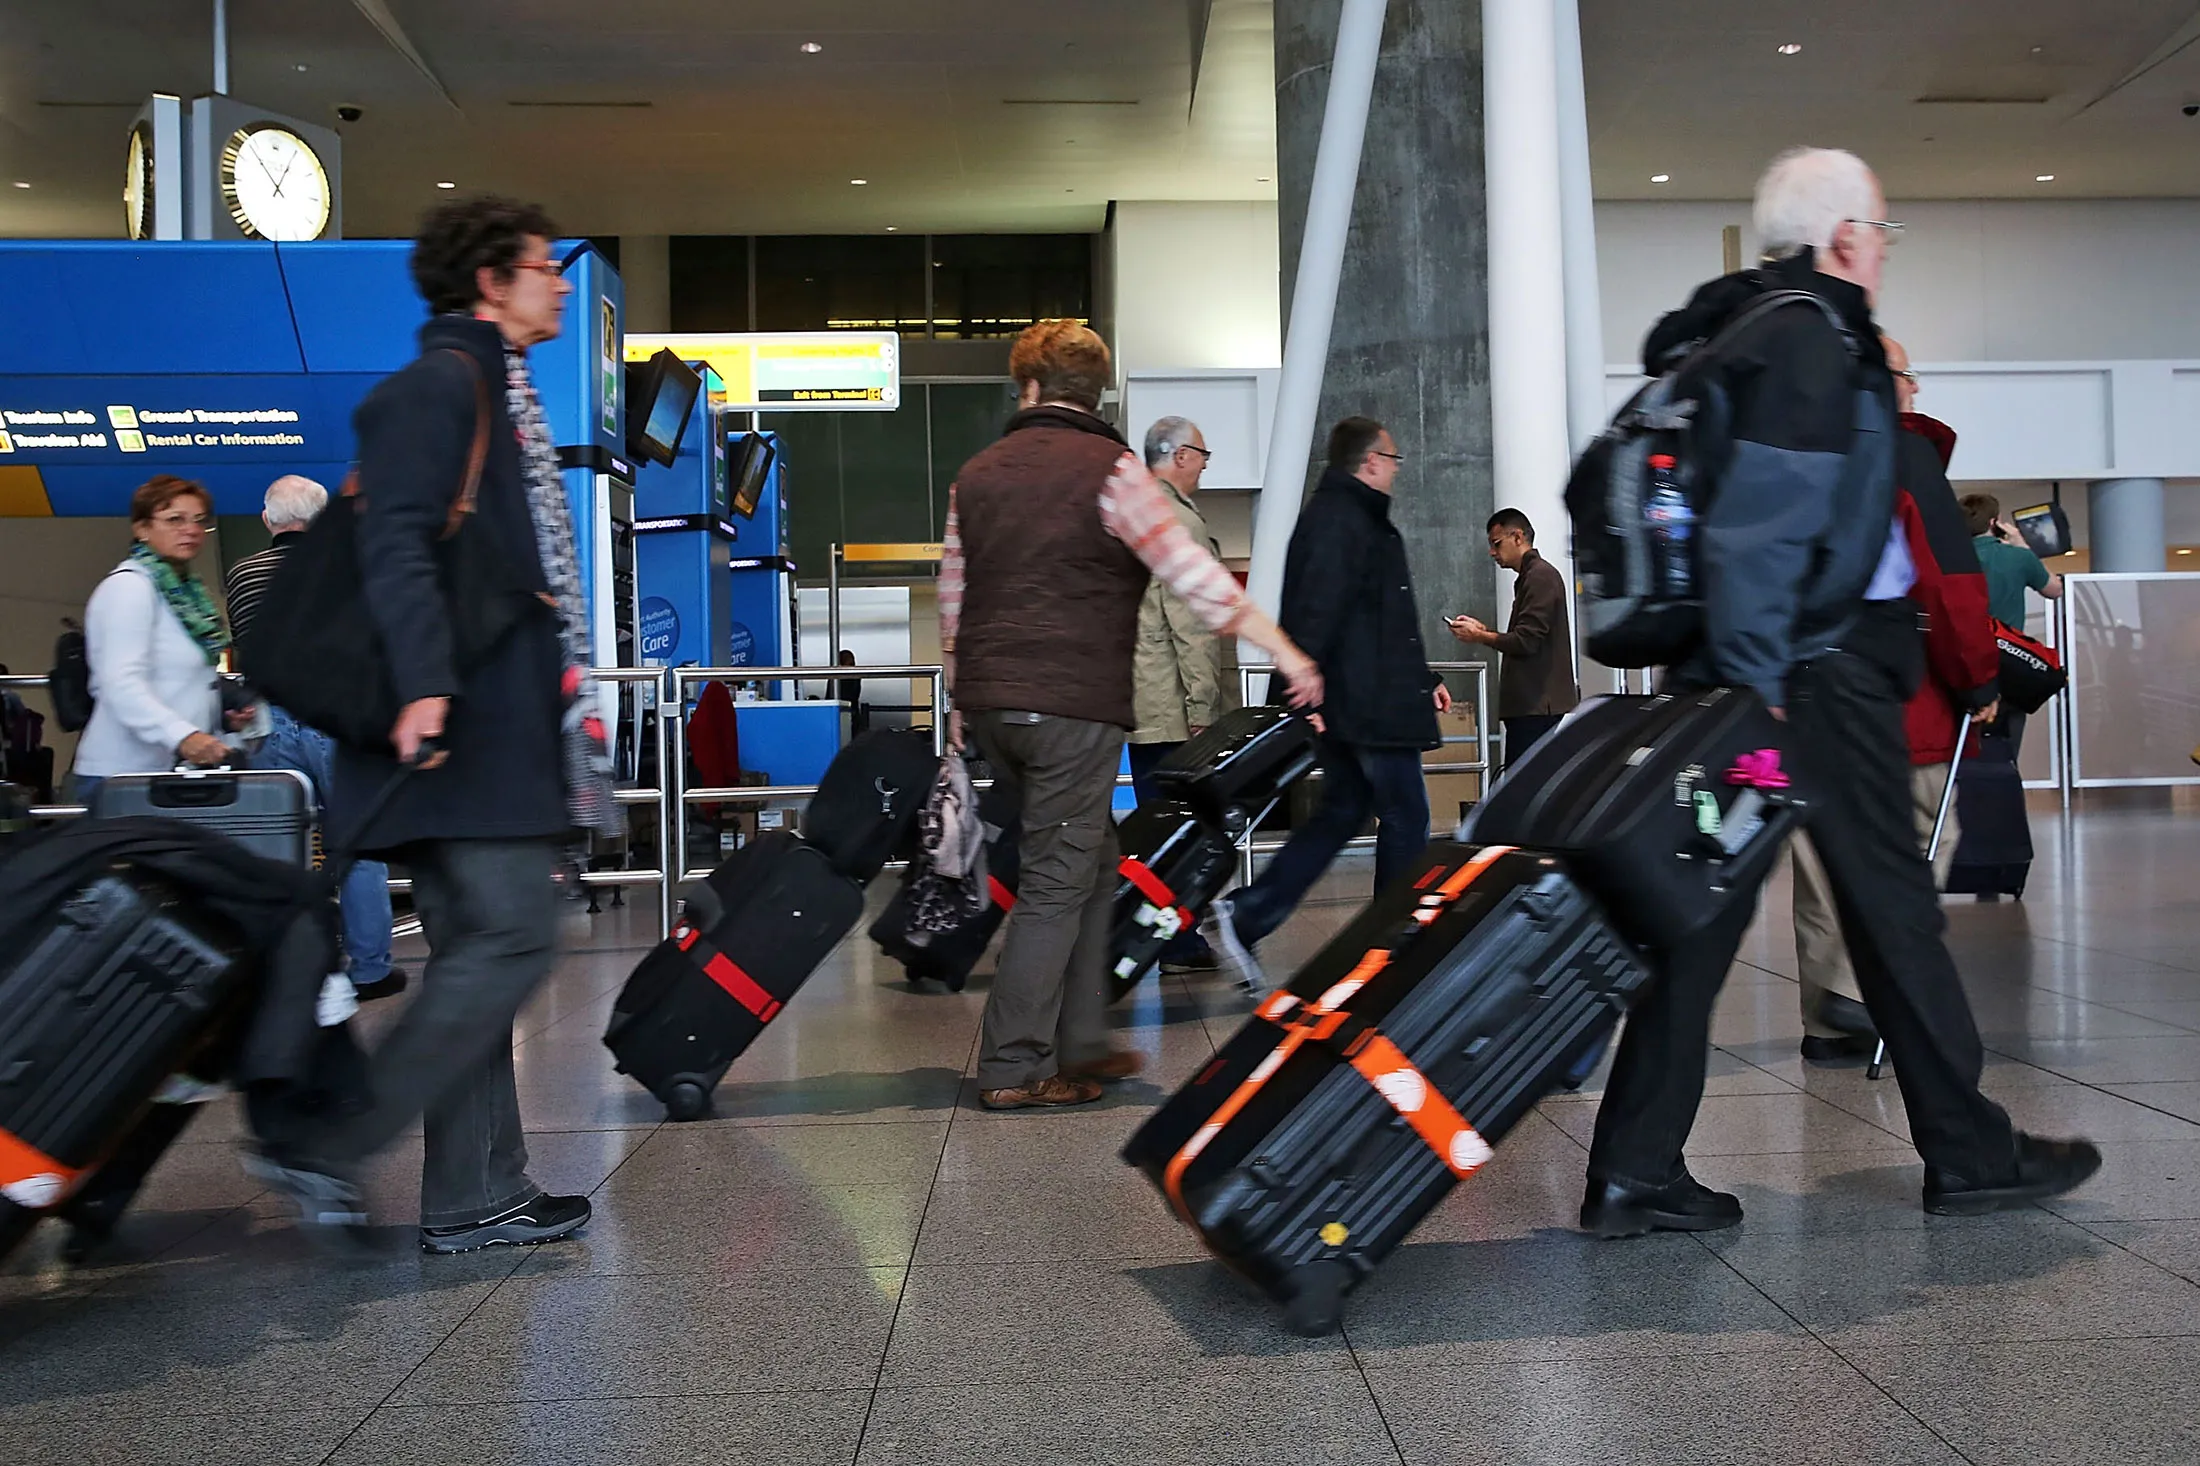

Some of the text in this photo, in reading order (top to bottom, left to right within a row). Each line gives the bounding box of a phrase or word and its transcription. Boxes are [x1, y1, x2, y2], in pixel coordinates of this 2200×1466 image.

[793, 389, 867, 400] Exit from Terminal
[138, 408, 299, 425] Ground Transportation
[145, 432, 304, 446] Rental Car Information
[641, 634, 669, 653] Care
